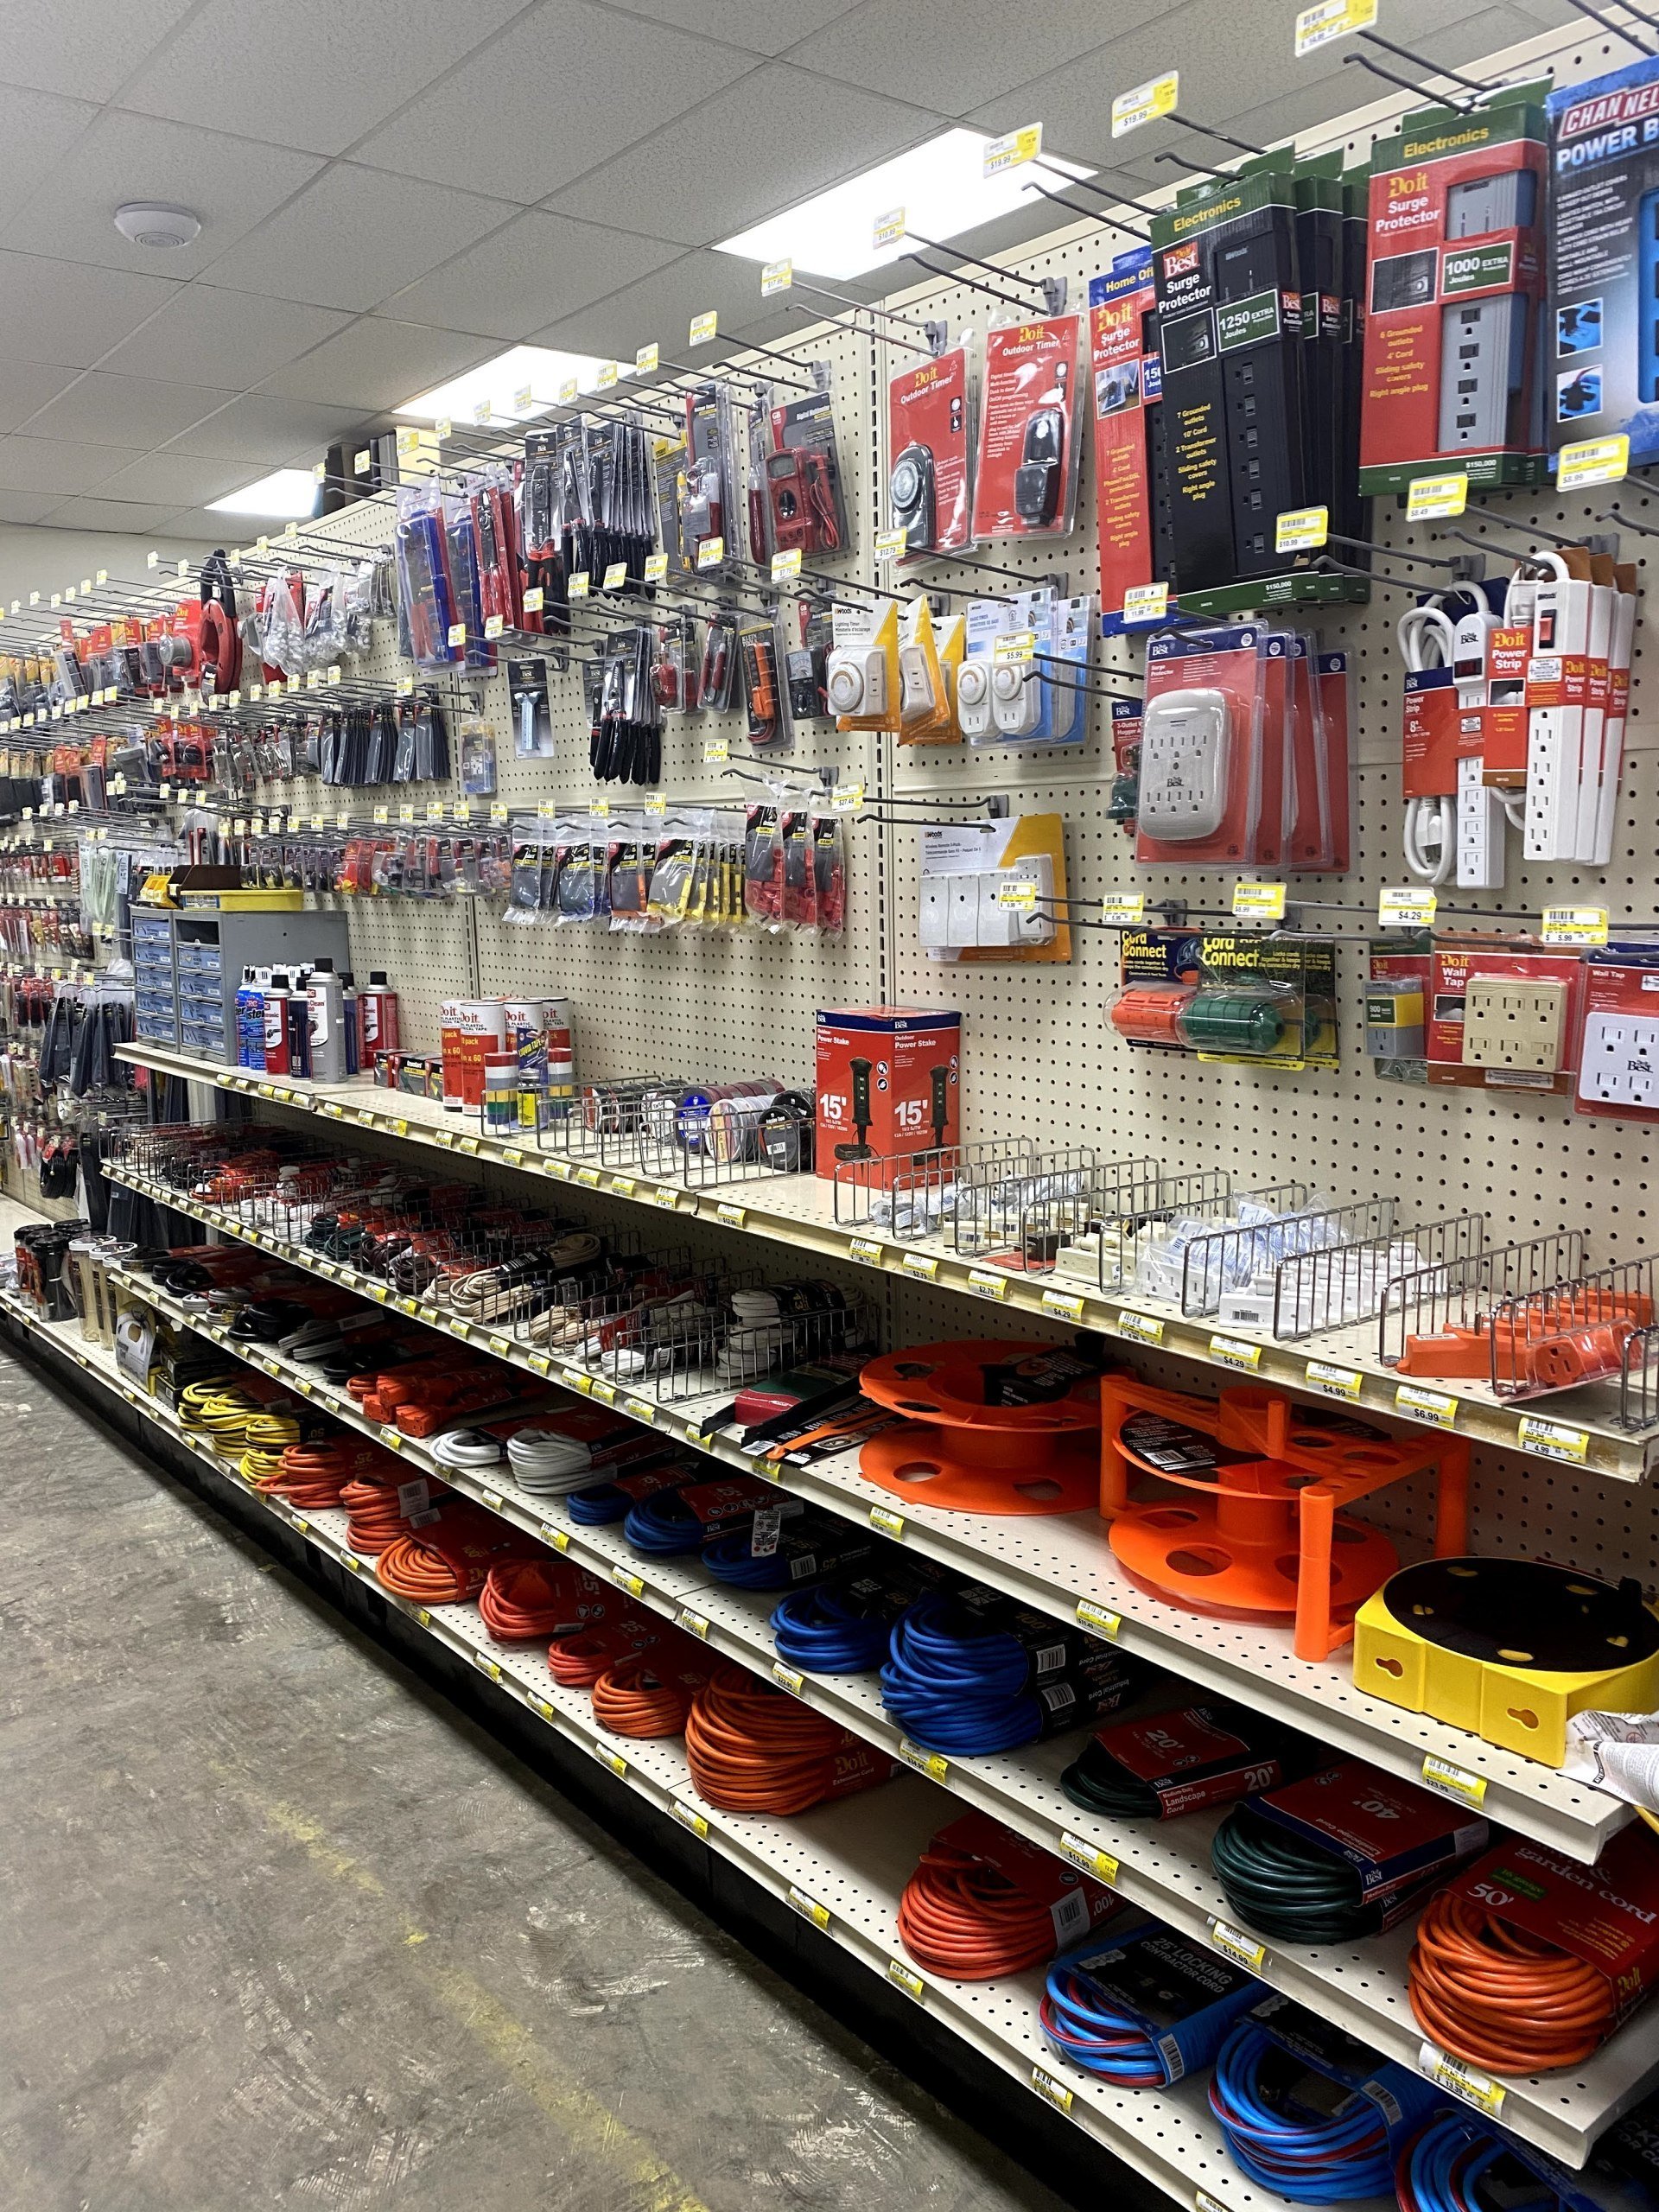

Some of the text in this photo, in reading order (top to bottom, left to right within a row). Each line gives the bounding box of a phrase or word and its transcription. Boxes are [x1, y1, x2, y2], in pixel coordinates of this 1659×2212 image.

[1123, 110, 1148, 127] $19.99
[1403, 125, 1490, 159] Electronics
[1556, 125, 1638, 172] POWER
[990, 154, 1012, 170] $19.99
[1388, 196, 1429, 215] Surge
[1173, 196, 1242, 232] Electronics
[1376, 208, 1441, 232] Protector
[1163, 249, 1200, 279] Best
[1446, 256, 1510, 275] 1000 EXTRA
[1105, 275, 1136, 294] Home
[1166, 274, 1200, 296] Surge
[1448, 274, 1475, 285] Joules
[1158, 284, 1211, 314] Protector
[1219, 307, 1274, 331] 1250 EXTRA
[1101, 326, 1130, 347] Surge
[1224, 327, 1247, 340] Joules
[1386, 325, 1423, 338] Grounded
[1002, 339, 1060, 357] Outdoor Timer
[1388, 336, 1414, 347] outlets
[1093, 337, 1141, 362] Protector
[1395, 349, 1414, 359] Cord
[1375, 361, 1425, 376] Sliding safety
[1387, 372, 1413, 383] covers
[900, 374, 953, 405] Outdoor Timer
[1370, 383, 1429, 398] Right angle plug
[1182, 403, 1211, 417] Grounded
[1184, 415, 1205, 426] outlets
[1192, 425, 1207, 435] Cord
[1180, 436, 1217, 452] Transformer
[1186, 448, 1207, 459] outlets
[1178, 459, 1217, 474] Sliding safety
[1465, 459, 1497, 469] $150,000
[1187, 469, 1208, 480] covers
[1182, 480, 1216, 493] Right angle
[1192, 492, 1206, 501] plug
[1265, 581, 1292, 592] $150,000
[1006, 651, 1023, 660] $5.99
[1152, 644, 1169, 657] Best
[1491, 649, 1528, 659] Power
[1495, 659, 1522, 671] Strip
[1565, 675, 1586, 684] Power
[1567, 683, 1583, 694] Strip
[1406, 695, 1424, 704] Power
[1405, 703, 1421, 714] Strip
[1398, 911, 1422, 921] $4.29
[1557, 933, 1573, 943] 5.99
[1122, 944, 1167, 959] Connect
[1202, 947, 1260, 968] Connect
[1442, 967, 1466, 977] Wall
[1592, 969, 1625, 981] Wall Tap
[1443, 977, 1465, 988] Tap
[817, 1034, 849, 1046] Power Stake
[473, 1054, 482, 1063] 60
[978, 1285, 995, 1295] $2.79
[1053, 1307, 1071, 1319] $4.29
[1224, 1356, 1245, 1369] $4.29
[1323, 1384, 1346, 1397] $4.99
[1414, 1408, 1440, 1423] $6.99
[1535, 1445, 1550, 1454] 4.99
[1088, 1679, 1130, 1701] Industrial Cord
[833, 1767, 874, 1786] Extension Cord
[1426, 1777, 1449, 1793] $23.99
[1165, 1790, 1206, 1807] Landscape
[1166, 1804, 1185, 1815] Cord
[1068, 1851, 1090, 1869] $12.99
[1365, 1872, 1382, 1886] Best
[1515, 1847, 1596, 1891] garden
[1599, 1888, 1659, 1925] cord
[1223, 1944, 1249, 1965] $14.99
[1140, 1941, 1225, 1994] CONTRACTOR CORD
[1173, 1946, 1234, 1986] LOCKING
